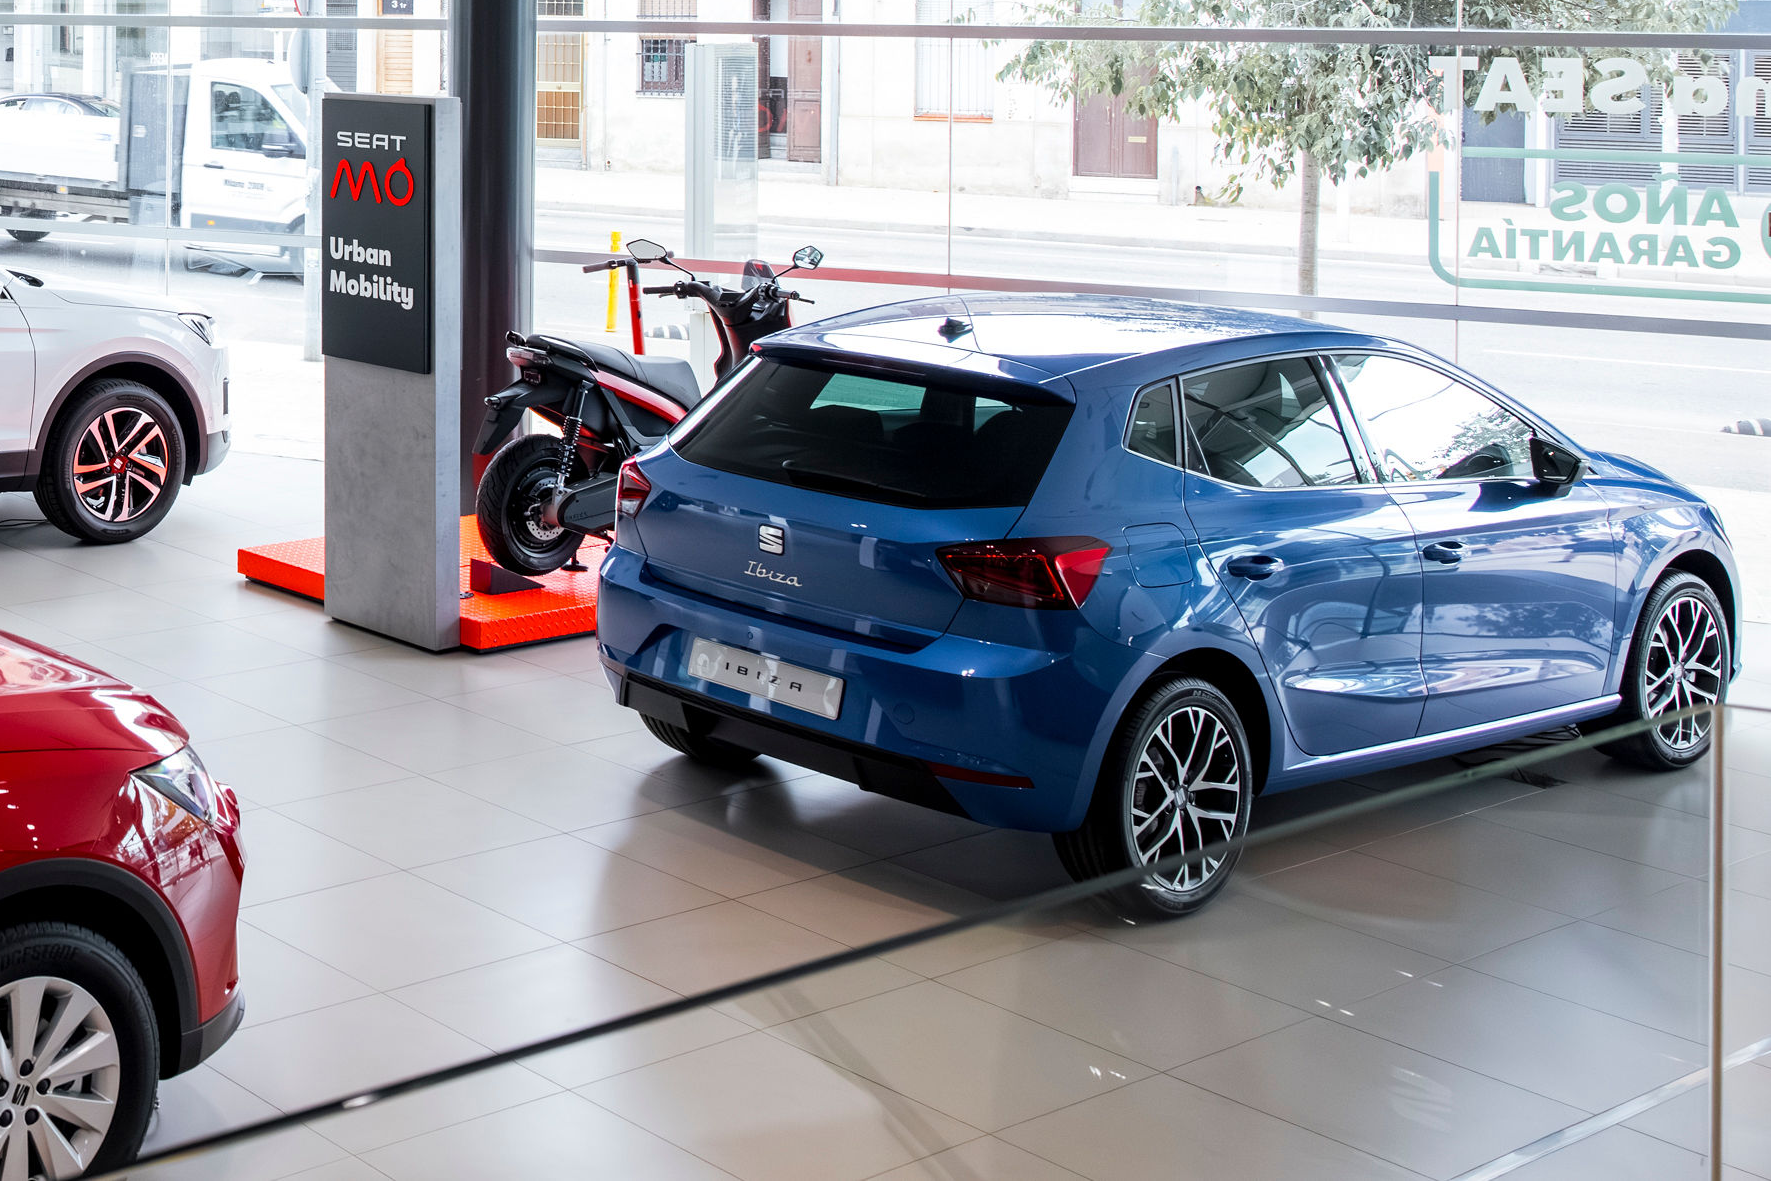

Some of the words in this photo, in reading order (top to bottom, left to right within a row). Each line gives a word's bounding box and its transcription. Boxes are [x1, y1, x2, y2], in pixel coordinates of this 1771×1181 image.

[336, 130, 407, 152] SEAT
[329, 236, 392, 267] Urban
[329, 269, 414, 310] Mobility
[743, 560, 803, 588] Ibiza
[725, 661, 803, 693] IBIZA
